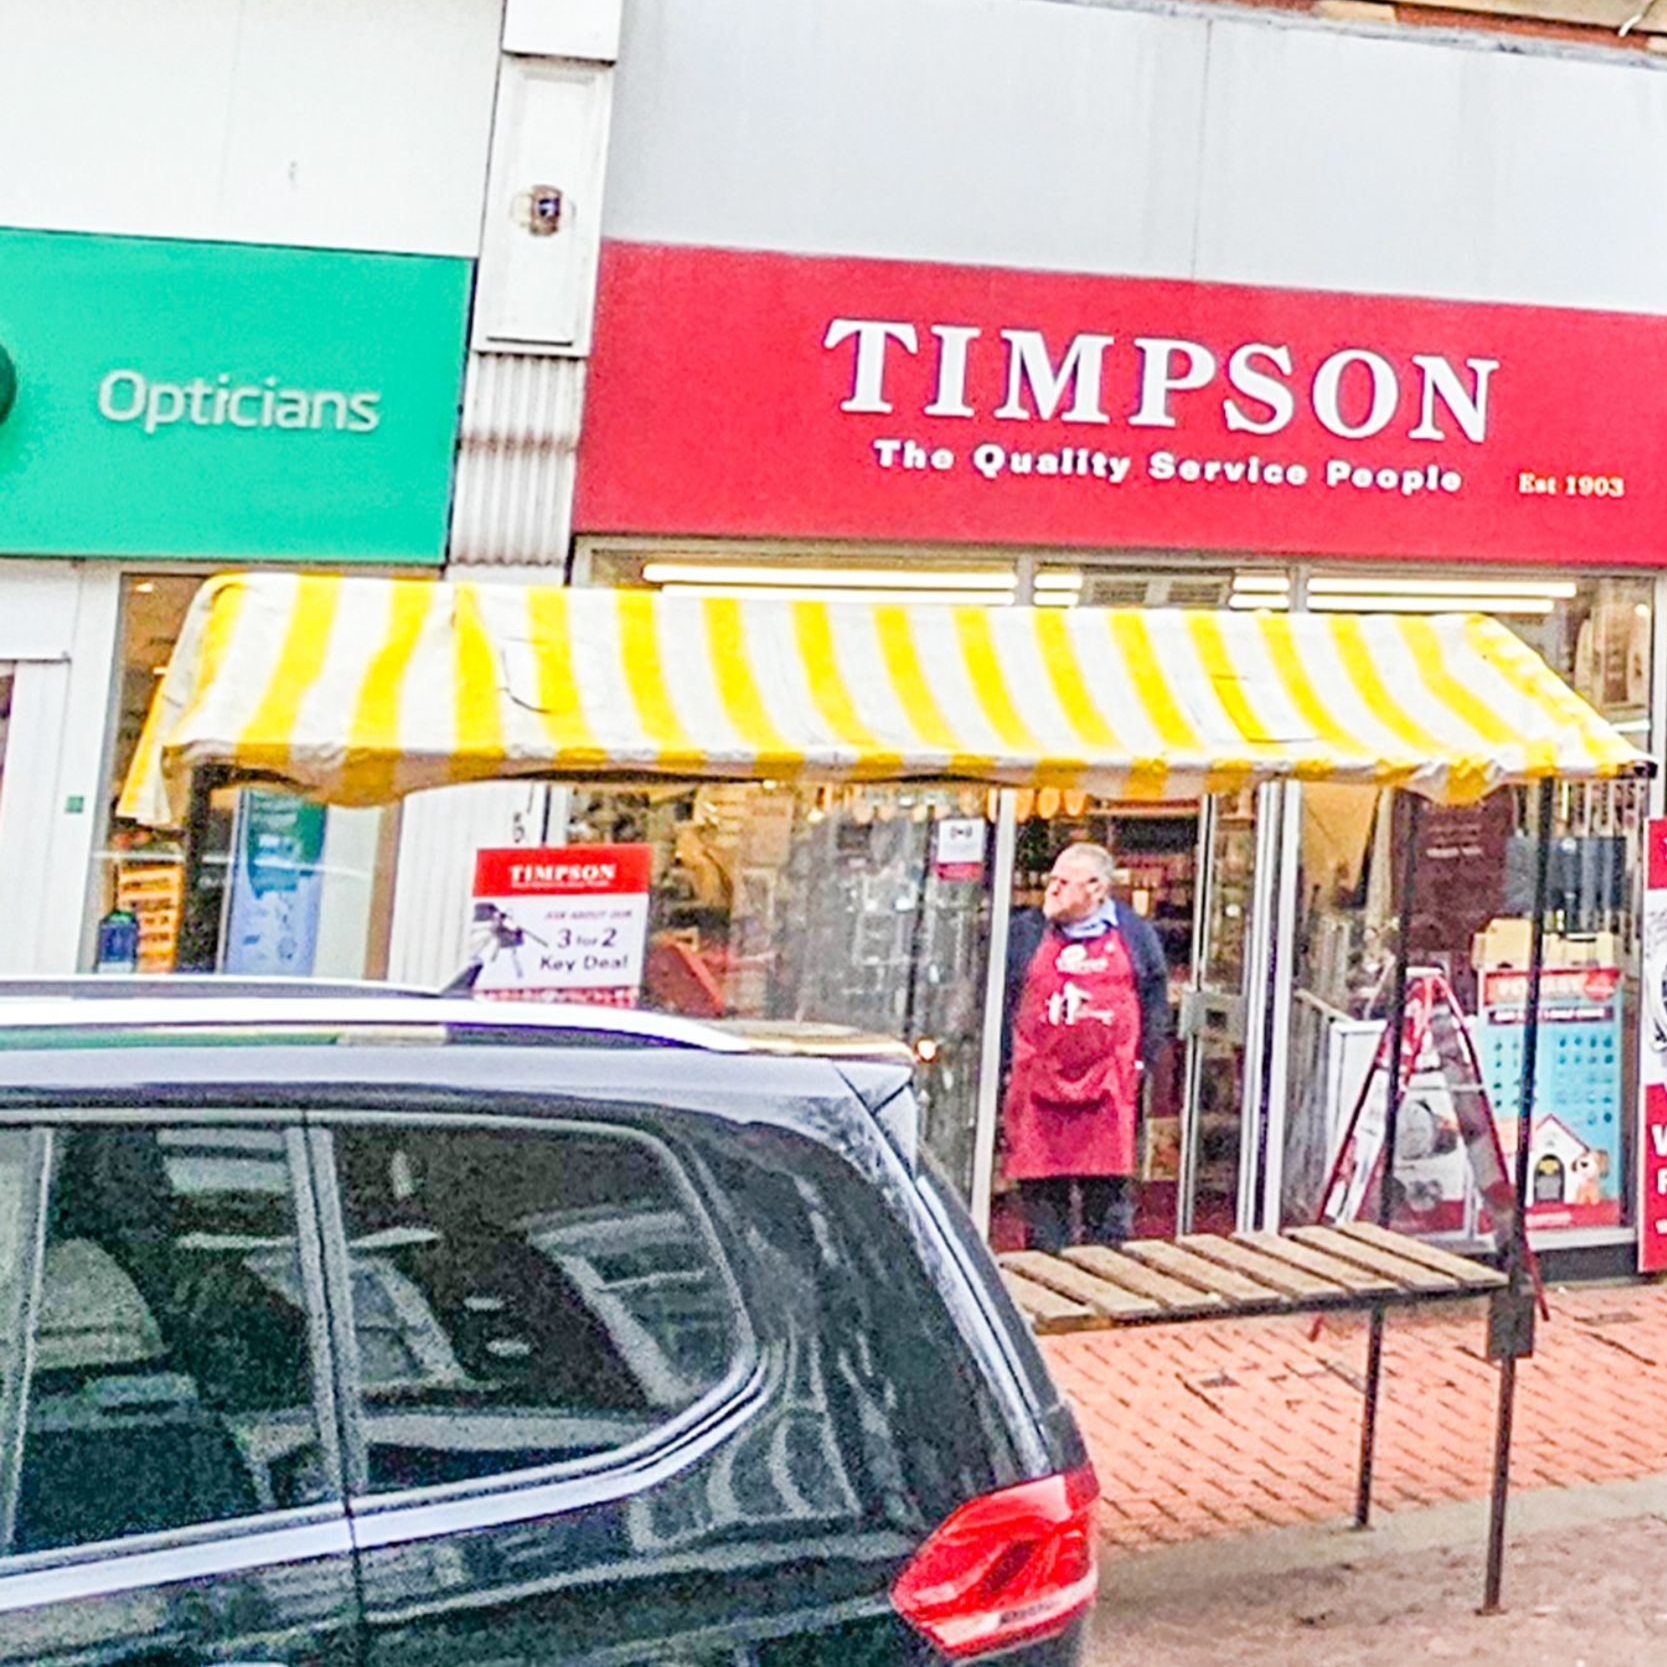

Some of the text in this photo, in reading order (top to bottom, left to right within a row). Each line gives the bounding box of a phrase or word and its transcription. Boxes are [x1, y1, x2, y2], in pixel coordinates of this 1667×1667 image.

[824, 318, 1499, 443] TIMPSON
[98, 369, 381, 434] Opticians
[873, 439, 1462, 495] The Quality Service People
[1518, 472, 1625, 498] Est 1903
[508, 863, 617, 881] TIMPSON
[556, 927, 573, 949] 3
[600, 927, 617, 947] 2
[539, 954, 628, 972] Key Deal
